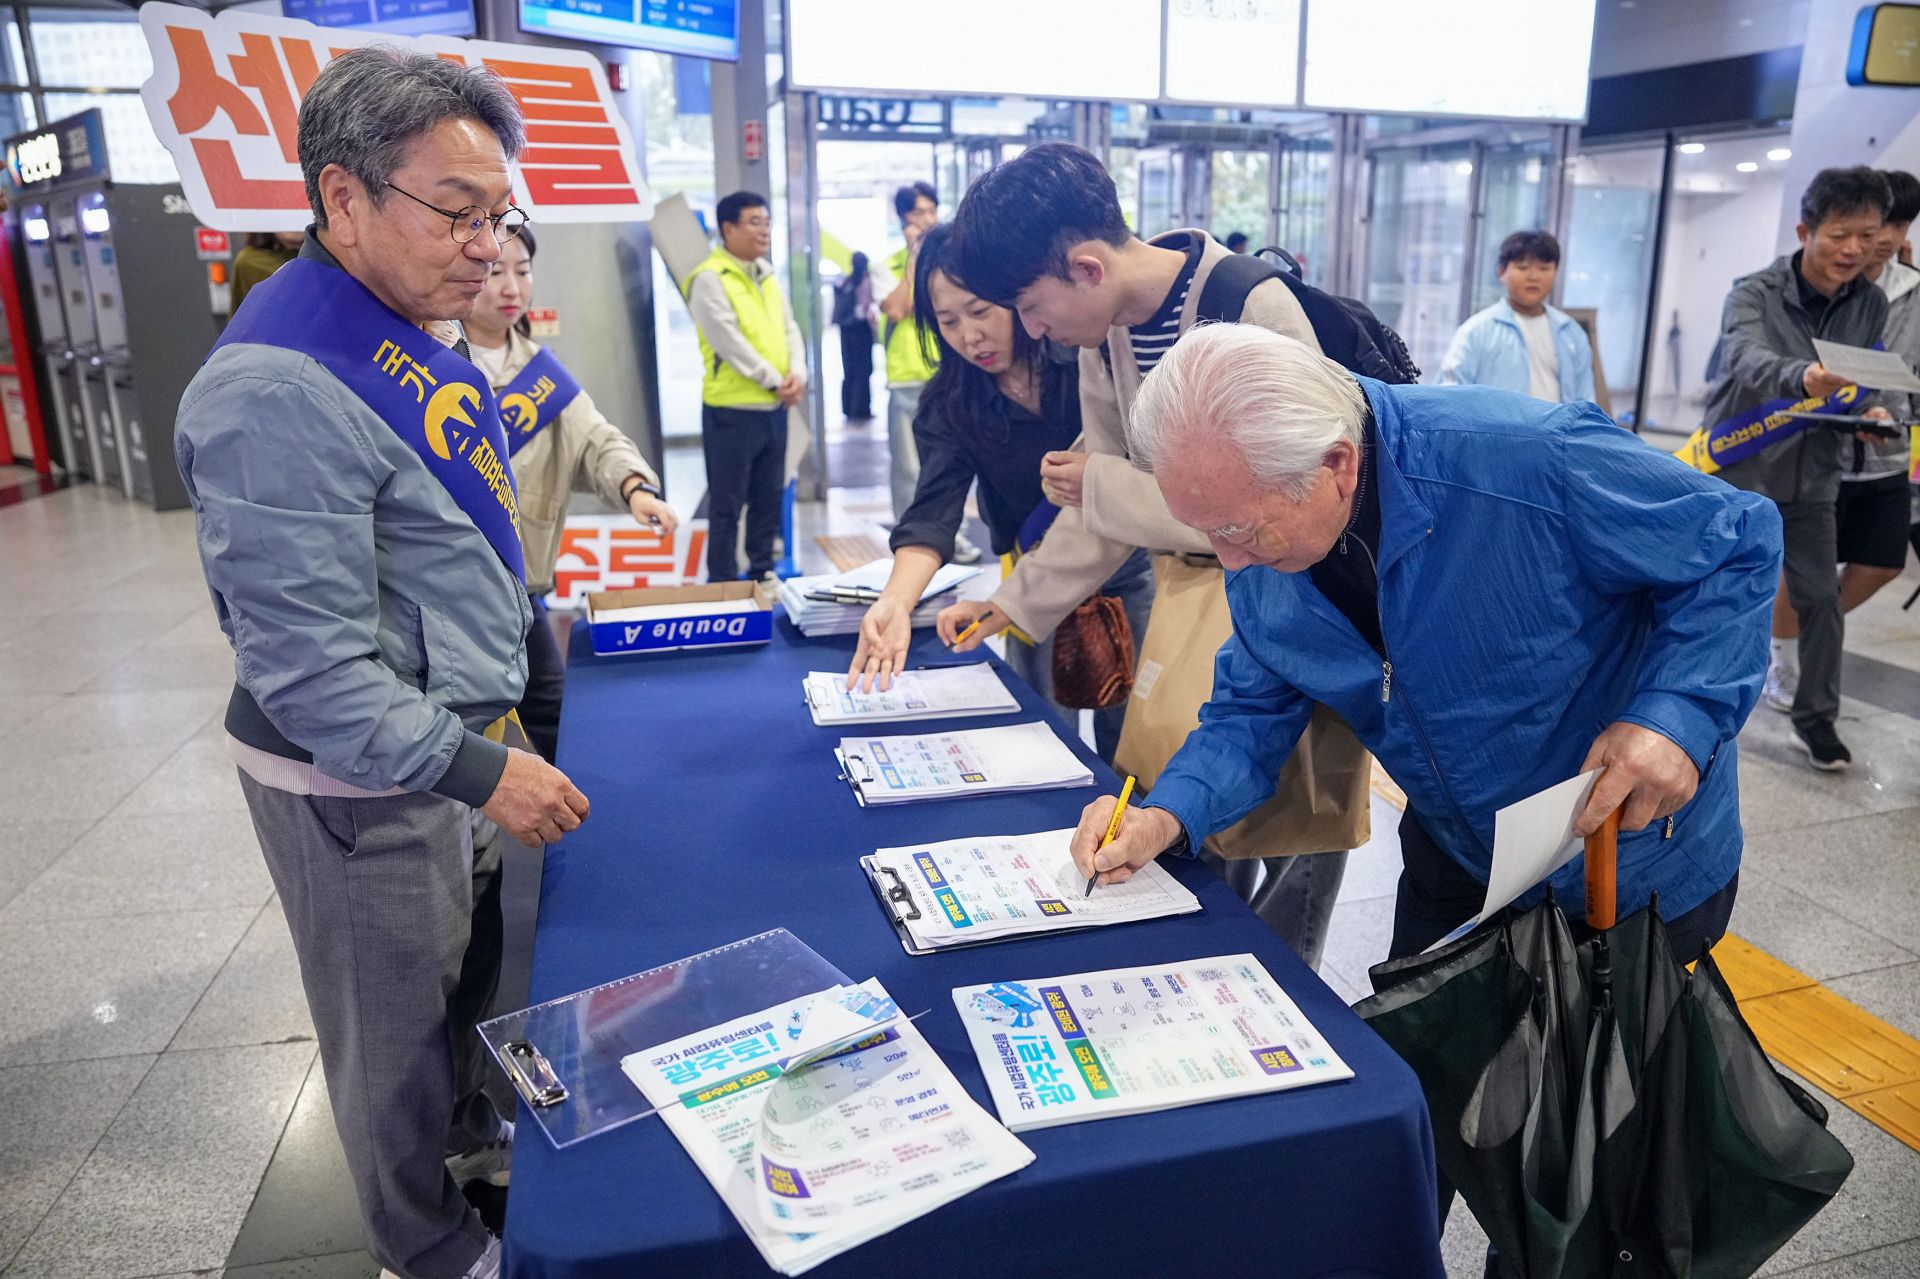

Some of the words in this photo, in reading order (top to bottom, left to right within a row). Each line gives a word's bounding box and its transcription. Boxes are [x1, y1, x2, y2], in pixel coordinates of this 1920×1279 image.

[164, 25, 640, 209] 센를
[372, 338, 438, 403] 국가
[623, 624, 643, 645] A
[652, 617, 747, 641] Double
[1044, 990, 1065, 1008] 광주!
[1060, 1010, 1078, 1033] 준비된
[651, 1053, 681, 1067] 국가
[680, 1022, 774, 1057] AI컴퓨팅센터를
[660, 1032, 782, 1086] 광주로!
[991, 1032, 1029, 1089] AI컴퓨팅센터를
[1012, 1034, 1077, 1107] 광주로!
[1016, 1090, 1038, 1110] 국가
